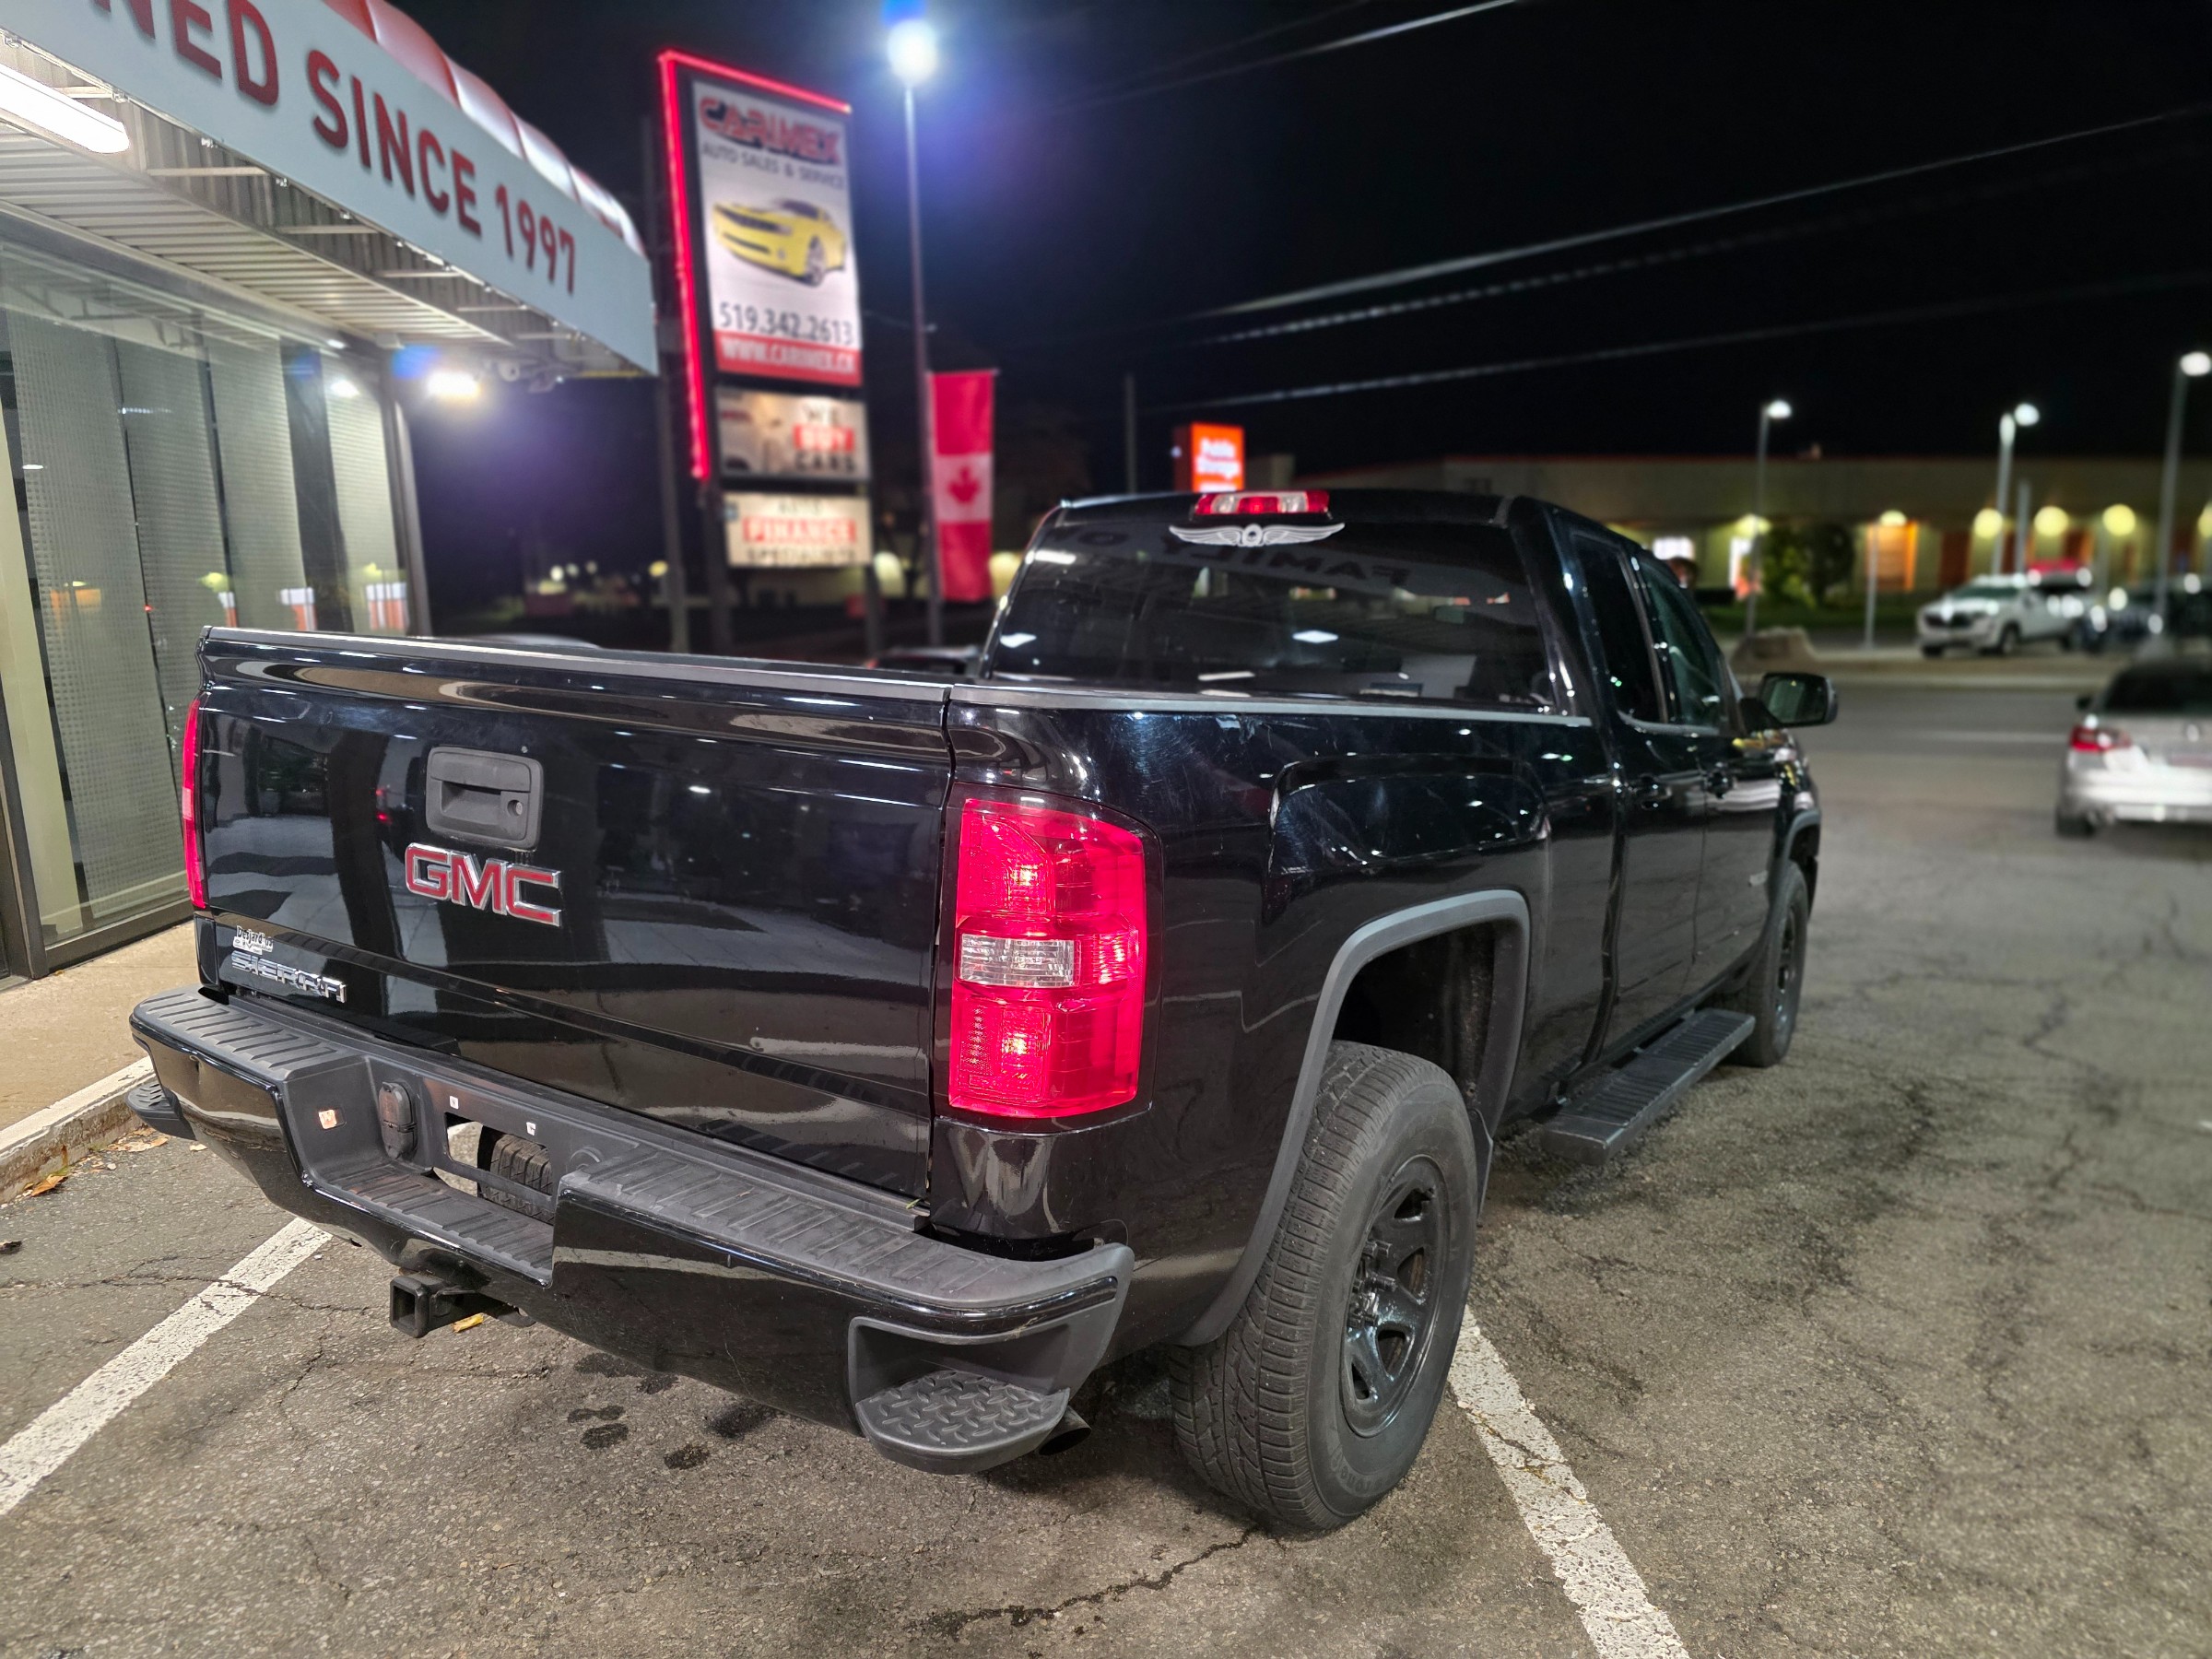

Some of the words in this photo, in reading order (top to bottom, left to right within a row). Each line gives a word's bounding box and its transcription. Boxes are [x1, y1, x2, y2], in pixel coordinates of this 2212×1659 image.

[91, 0, 279, 105] ED
[307, 50, 482, 236] SINCE
[495, 185, 576, 294] 1997
[702, 143, 737, 164] AUTO
[742, 151, 779, 174] SALES
[784, 163, 794, 177] &
[719, 301, 854, 346] 519.342.2613
[405, 842, 561, 927] GMC
[231, 950, 347, 1004] SIERRA
